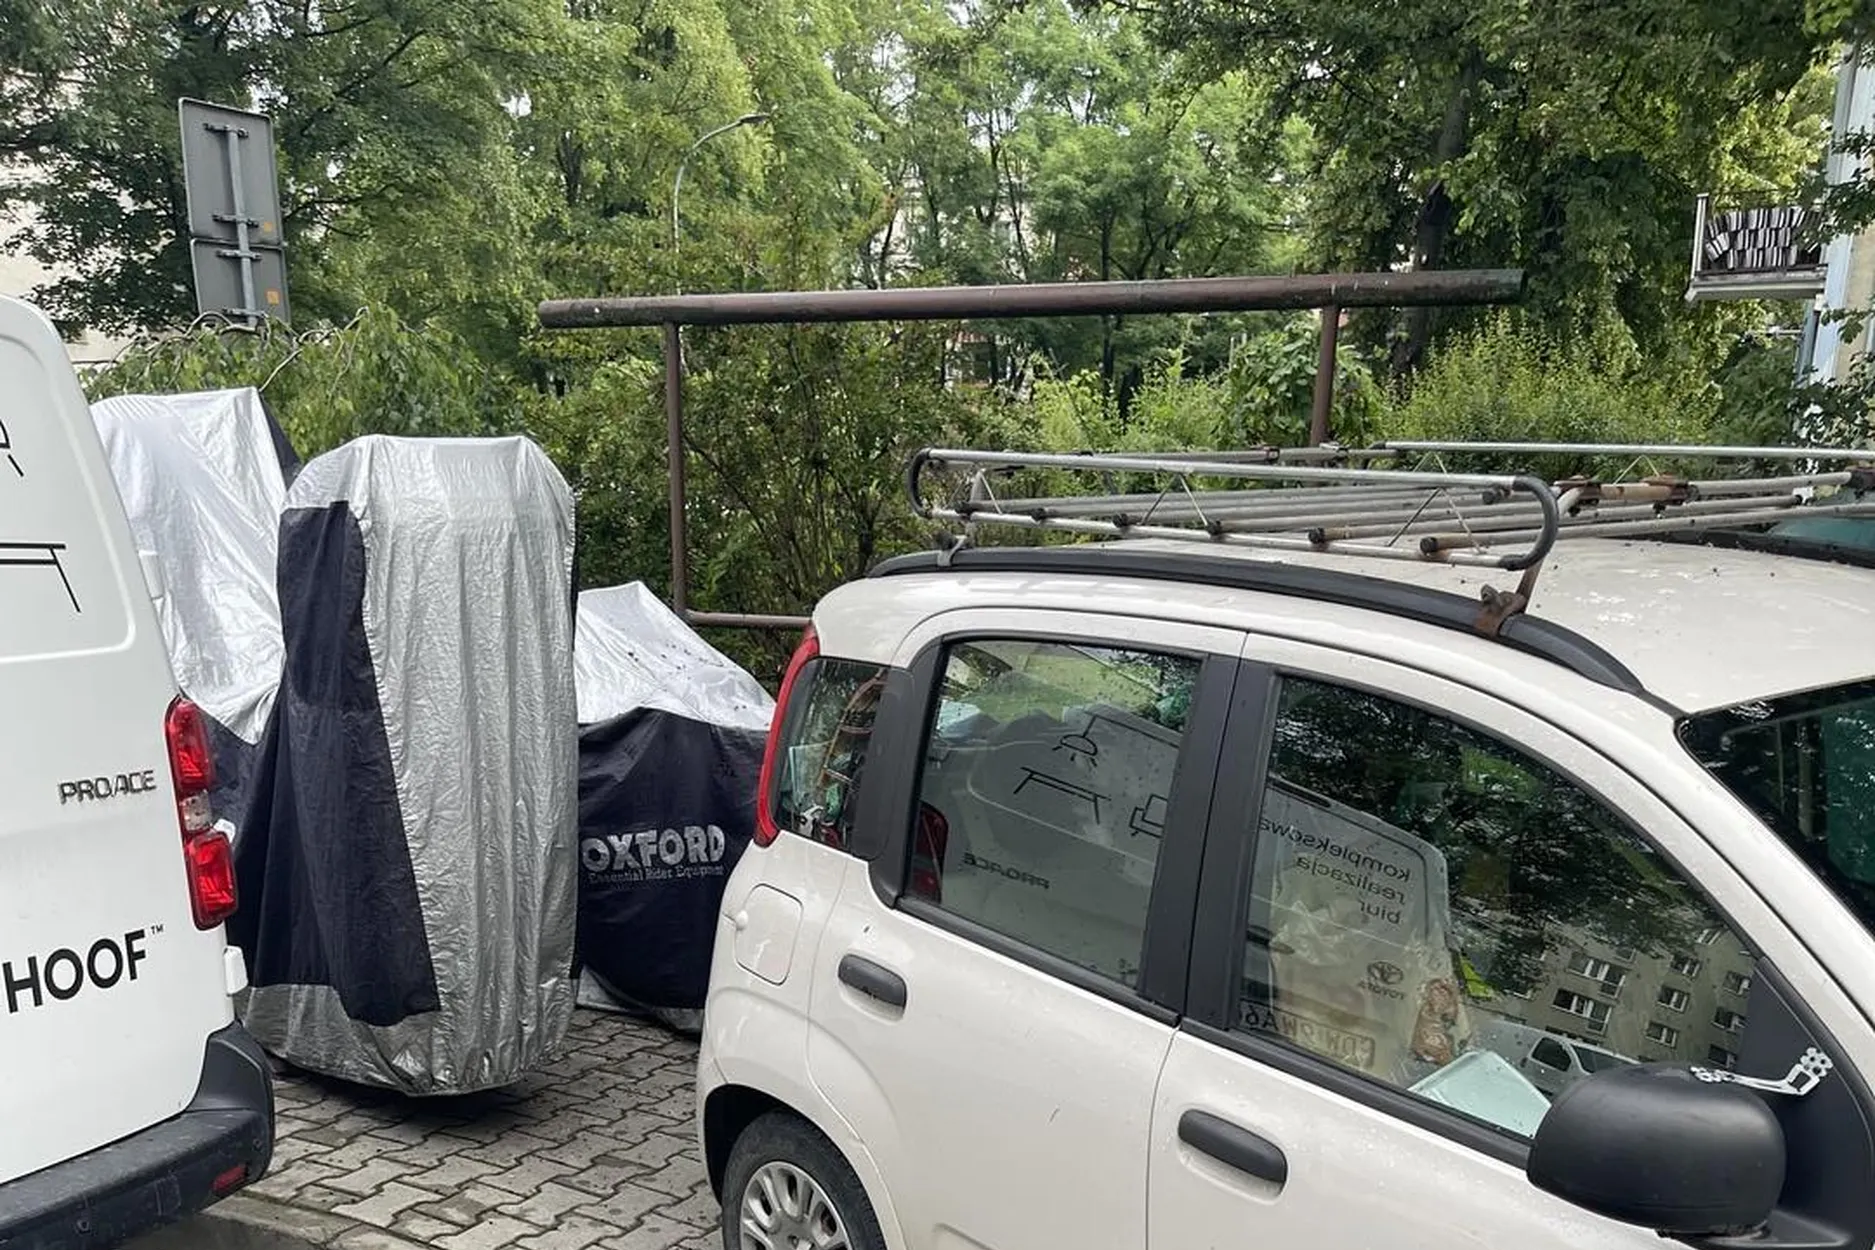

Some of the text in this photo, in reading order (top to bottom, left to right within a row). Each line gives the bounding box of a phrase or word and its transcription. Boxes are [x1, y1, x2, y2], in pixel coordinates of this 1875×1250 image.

[58, 770, 156, 804] PROACE
[581, 824, 725, 872] OXFORD
[2, 929, 146, 1014] HOOF
